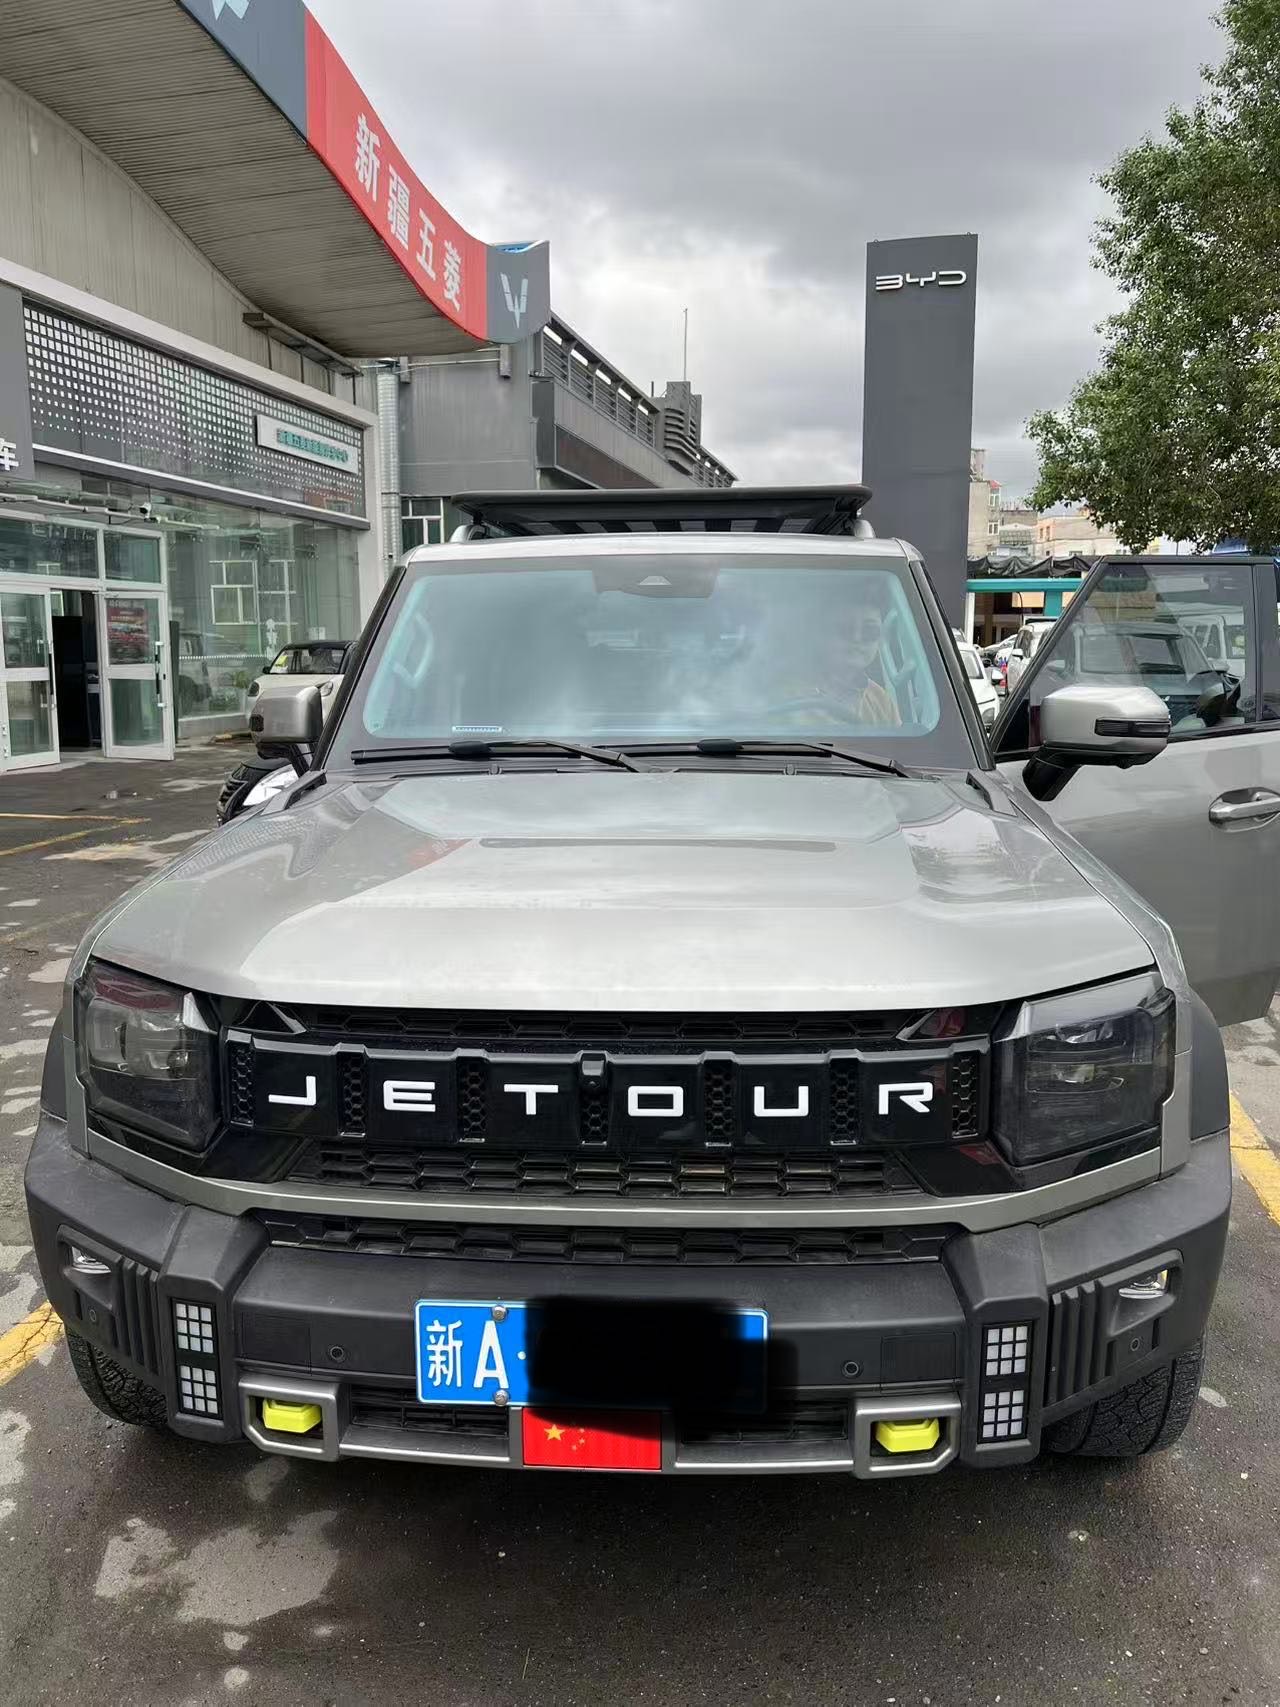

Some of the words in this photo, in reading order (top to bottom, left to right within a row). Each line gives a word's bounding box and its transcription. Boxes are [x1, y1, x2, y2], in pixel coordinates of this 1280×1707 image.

[355, 112, 461, 312] 新疆五菱
[876, 270, 967, 290] BYD
[269, 1075, 934, 1117] JETOUR
